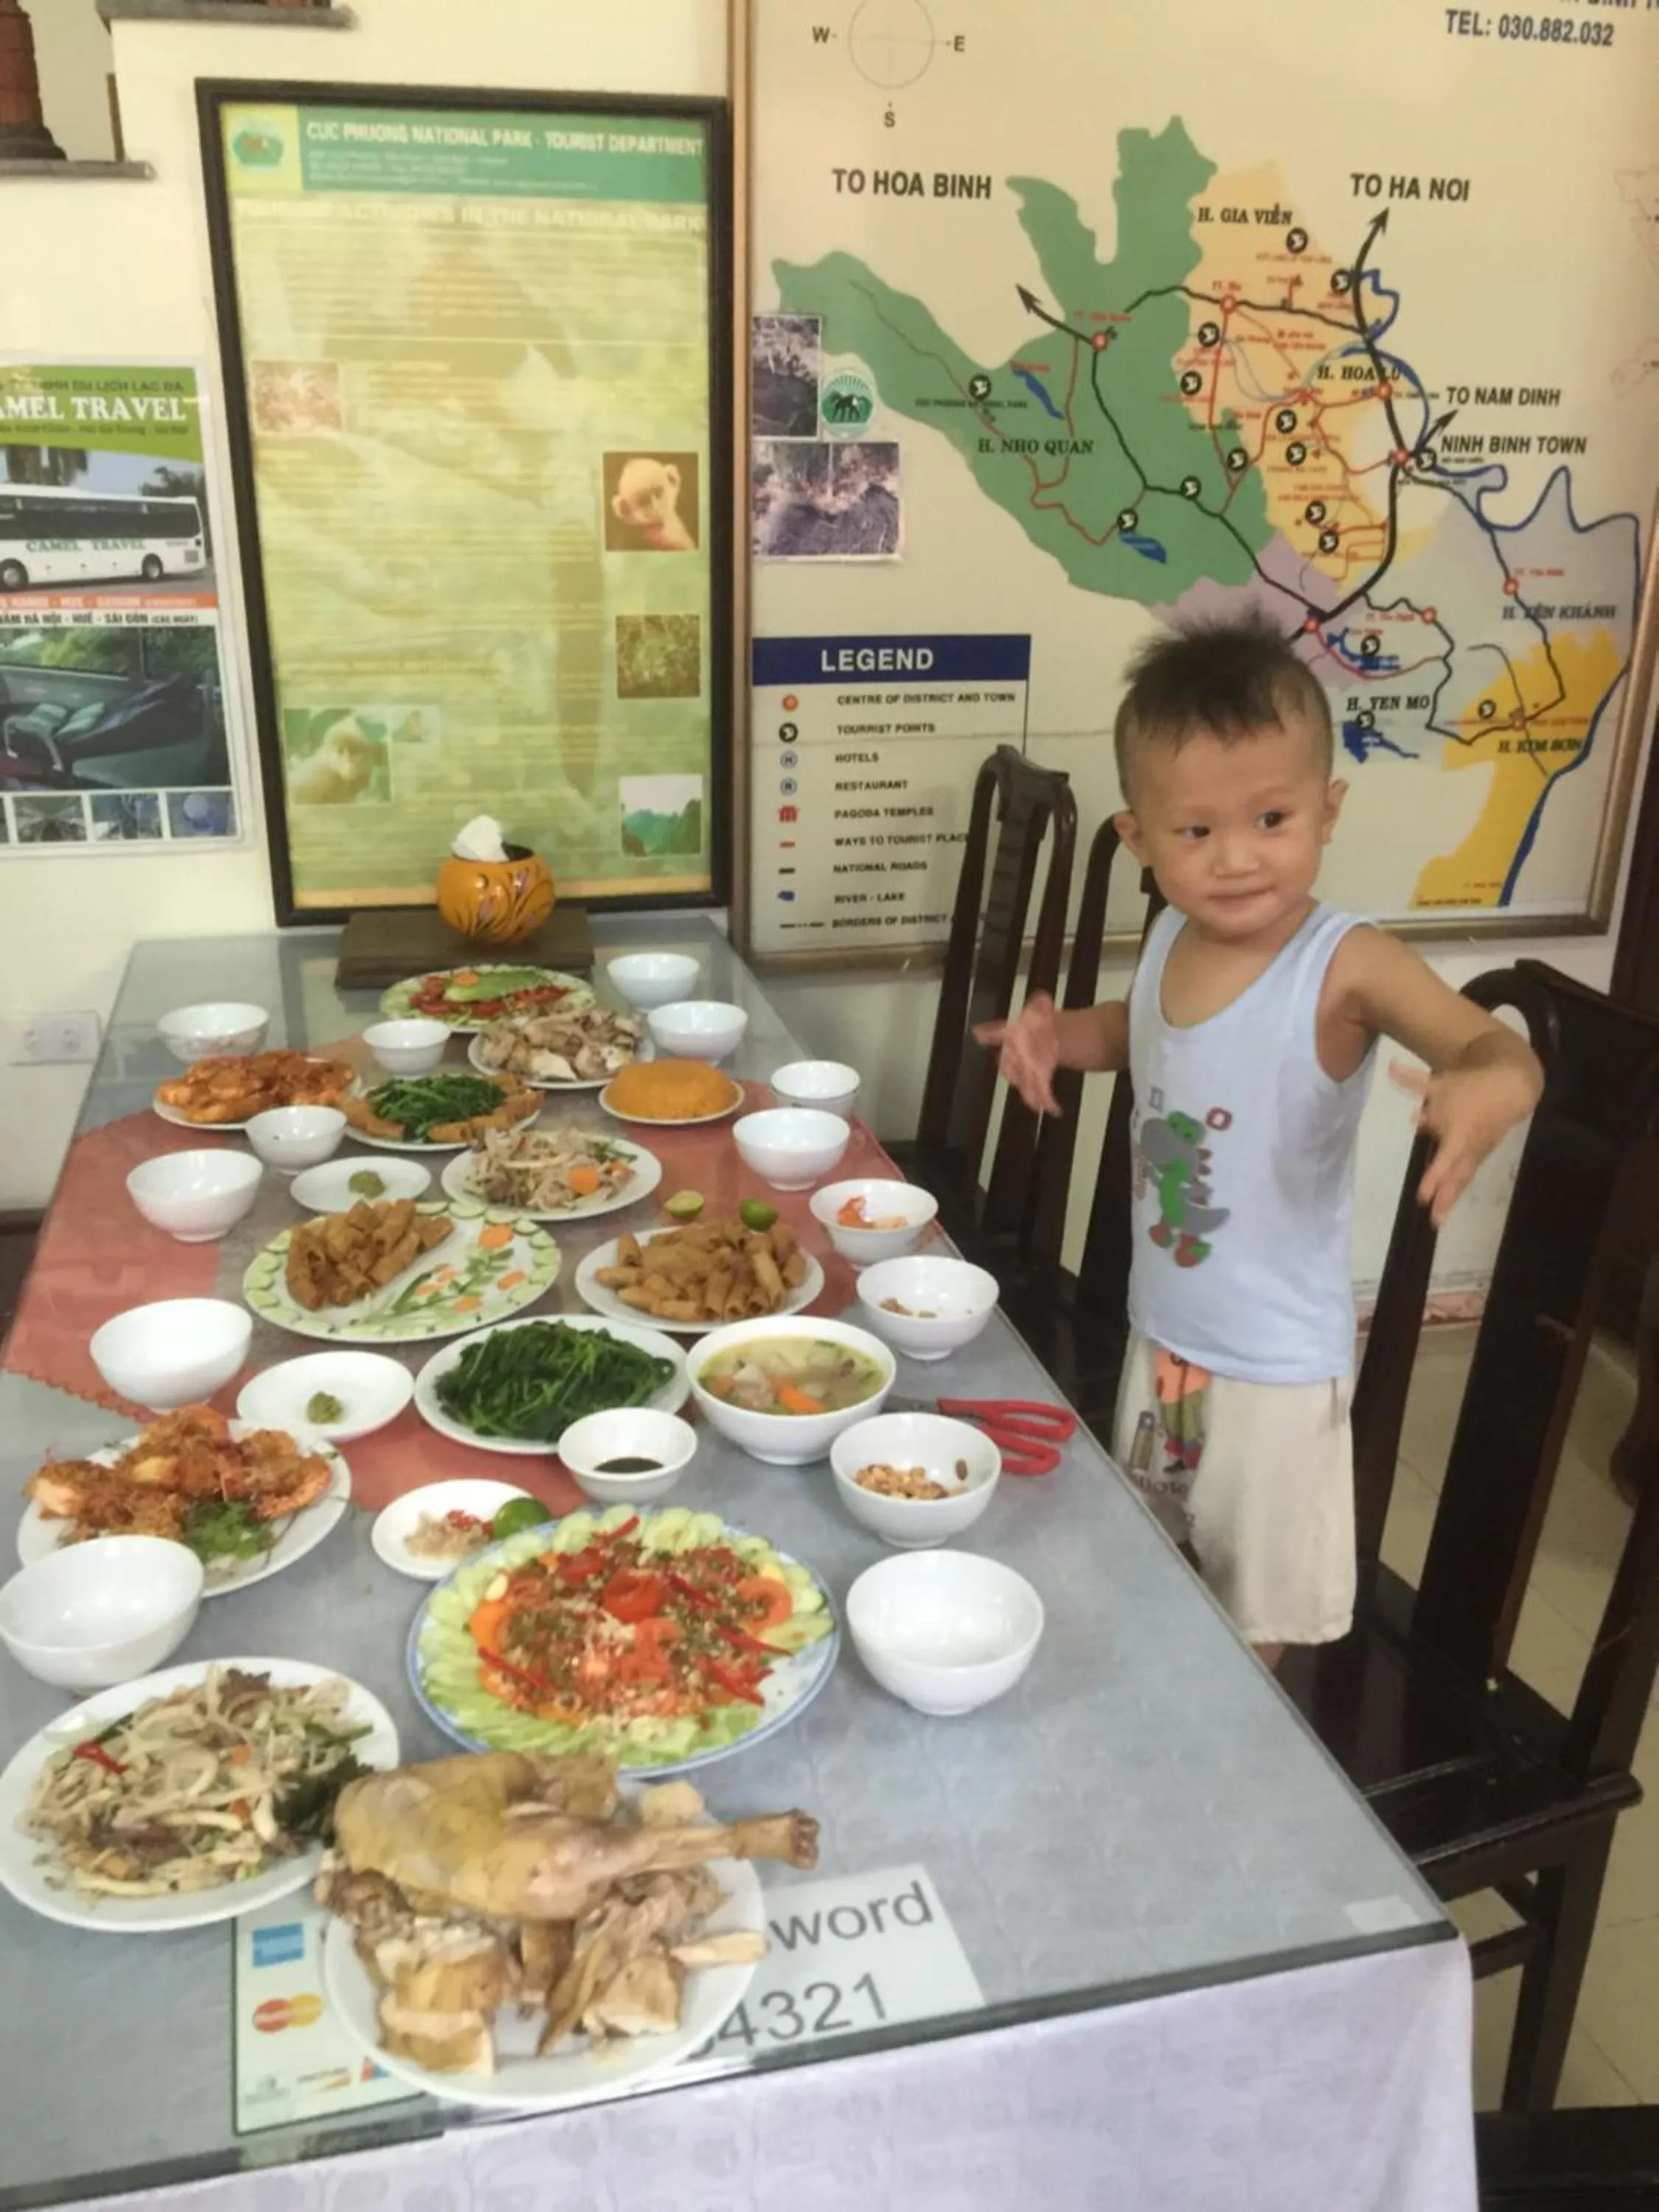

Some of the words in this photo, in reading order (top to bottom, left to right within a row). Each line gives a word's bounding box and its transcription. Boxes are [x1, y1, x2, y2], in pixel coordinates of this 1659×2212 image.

[1445, 9, 1492, 36] TEL:
[1498, 14, 1614, 46] 030.882.032
[954, 35, 964, 52] E
[884, 111, 895, 128] S
[411, 125, 487, 147] NATIONAL
[491, 128, 532, 147] PARK
[543, 131, 605, 152] TOURIST
[608, 133, 703, 156] DEPARTMENT
[832, 169, 864, 194] TO
[873, 171, 924, 197] HOA
[933, 173, 991, 199] BINH
[1351, 173, 1381, 198] TO
[1389, 175, 1419, 199] HA
[1430, 178, 1470, 201] NOI
[1220, 207, 1249, 223] GIA
[1341, 366, 1374, 380] HOA
[1447, 386, 1470, 405] TO
[1475, 387, 1512, 406] NAM
[1518, 388, 1561, 407] DINH
[71, 396, 187, 420] TRAVEL
[1001, 439, 1039, 454] NHO
[1044, 439, 1093, 456] QUAN
[1441, 436, 1484, 453] NINH
[1489, 436, 1531, 454] BINH
[1537, 436, 1587, 455] TOWN
[26, 540, 81, 552] CAMEL
[91, 539, 145, 551] TRAVEL
[821, 648, 933, 672] LEGEND
[837, 695, 883, 706] CENTRE
[886, 694, 901, 706] OF
[903, 693, 954, 704] DISTRICT
[957, 692, 981, 703] AND
[983, 692, 1015, 703] TOWN
[895, 723, 936, 734] POINTS
[835, 752, 879, 763] HOTELS
[835, 779, 908, 791] RESTAURANT
[834, 808, 880, 819] PAGODA
[884, 806, 934, 817] TEMPLES
[834, 836, 866, 847] WAYS
[870, 835, 884, 846] TO
[887, 834, 932, 845] TOURIST
[832, 863, 886, 874] NATIONAL
[890, 860, 928, 872] ROADS
[835, 894, 867, 904] RIVER
[877, 892, 906, 902] LAKE
[832, 917, 882, 928] BORDERS
[885, 915, 898, 926] OF
[900, 914, 947, 925] DISTRICT
[687, 1972, 887, 2059] 4321
